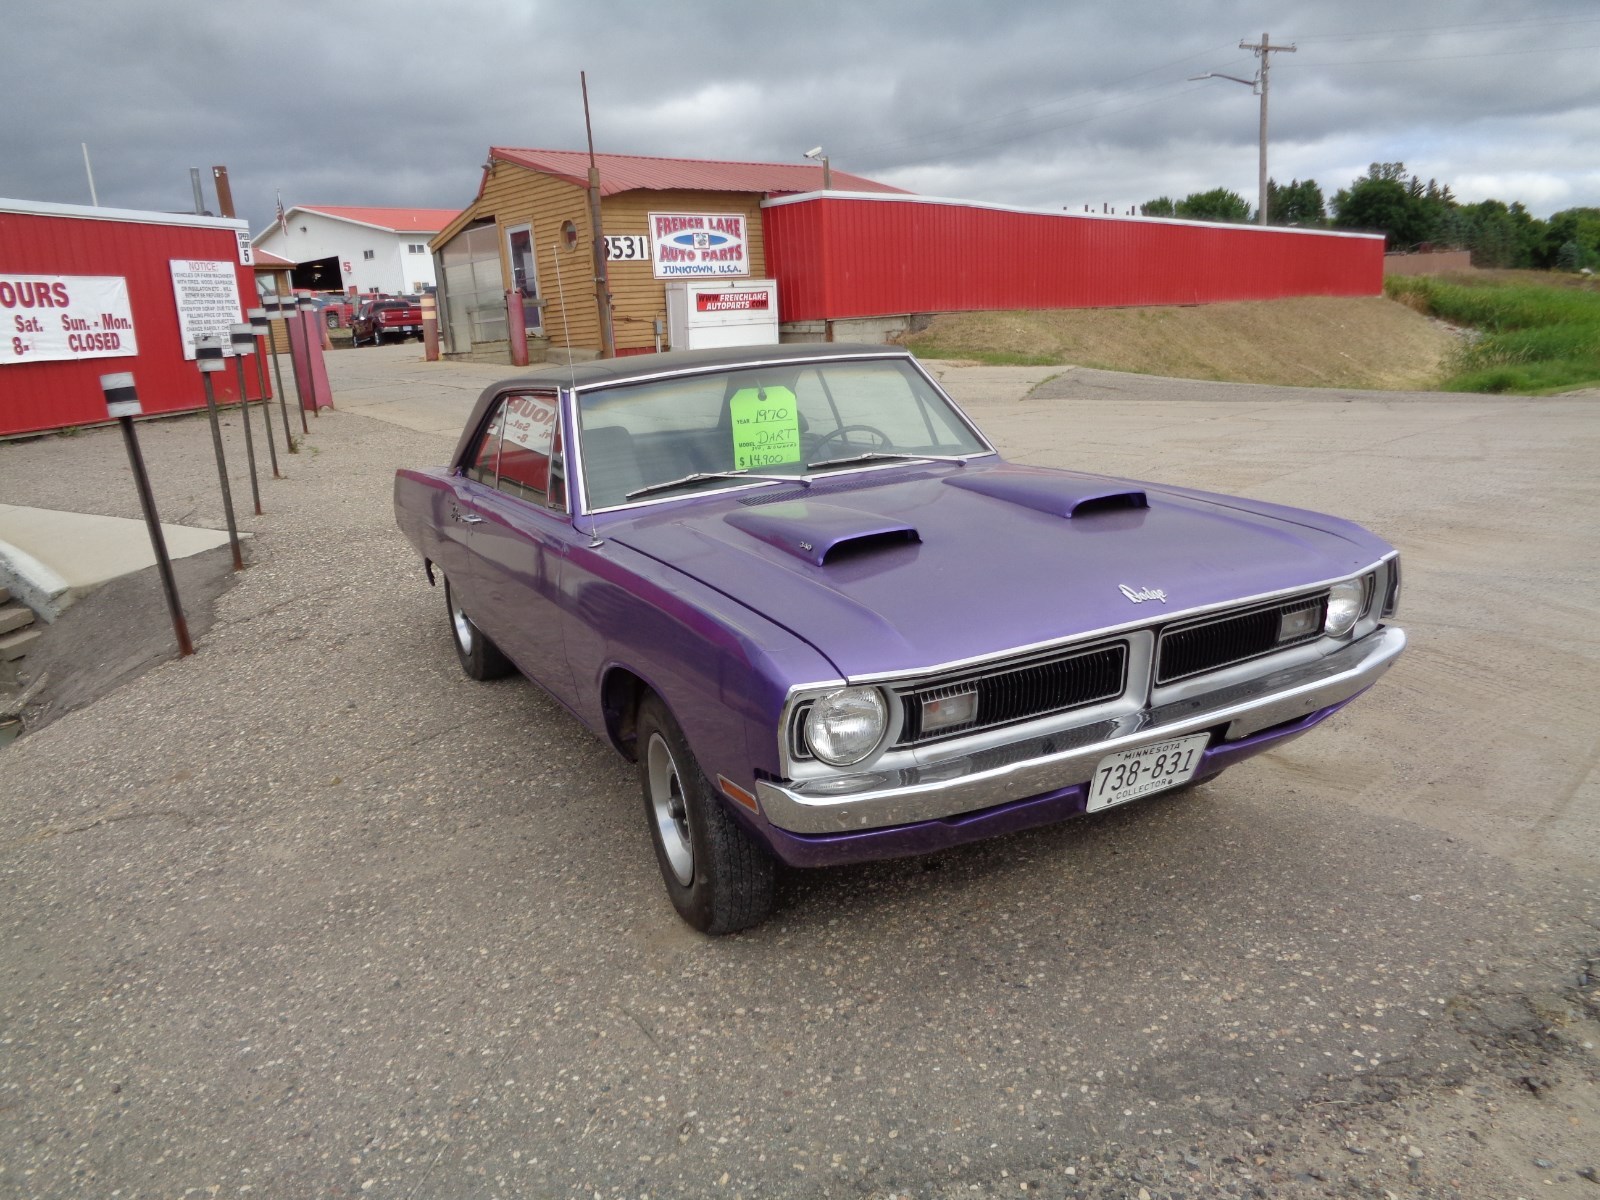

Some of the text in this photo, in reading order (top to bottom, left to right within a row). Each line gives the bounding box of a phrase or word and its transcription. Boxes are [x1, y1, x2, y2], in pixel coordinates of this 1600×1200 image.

[655, 217, 742, 240] FRENCH LAKE
[244, 250, 249, 262] 5
[659, 244, 743, 262] AUTO PARTS
[343, 262, 352, 272] 5
[663, 265, 716, 275] JUNKTOWN,
[14, 315, 44, 333] Sat.
[61, 314, 90, 331] Sun.
[101, 313, 132, 330] Mon.
[68, 333, 120, 352] CLOSED
[755, 408, 788, 423] 1970
[756, 428, 797, 444] DART
[1118, 584, 1168, 603] Dodge
[1123, 743, 1181, 760] MINNESOTA
[1099, 748, 1194, 796] 738-831
[1116, 778, 1167, 800] COLLECTOR
